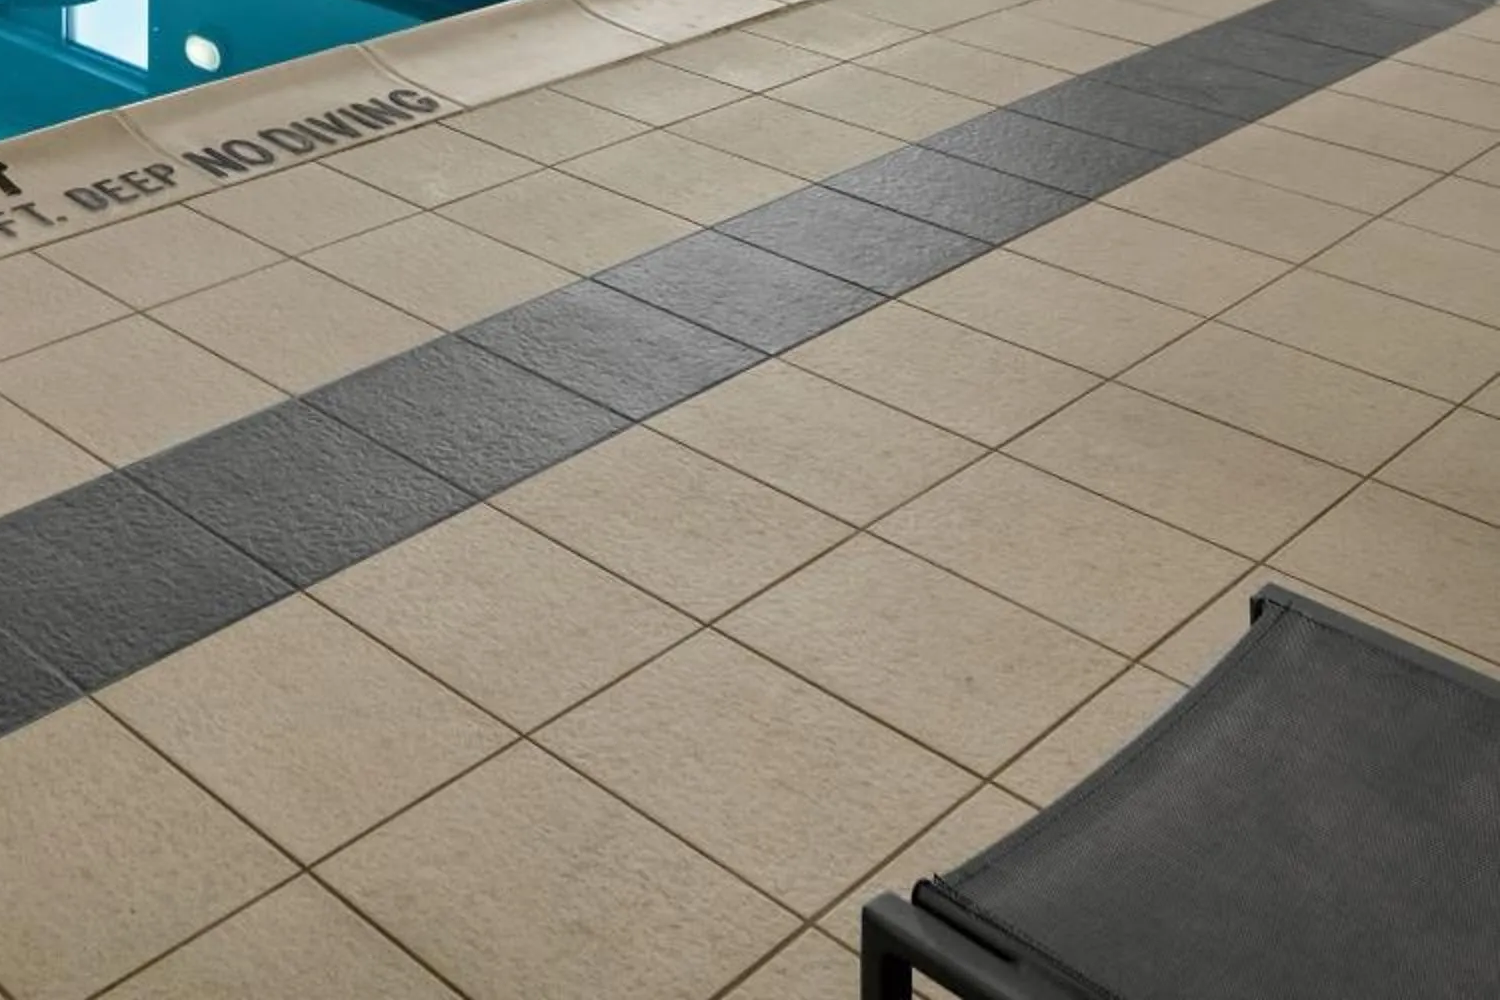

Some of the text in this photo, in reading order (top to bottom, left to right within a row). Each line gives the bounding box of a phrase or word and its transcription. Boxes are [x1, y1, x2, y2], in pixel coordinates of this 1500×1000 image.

[63, 164, 179, 212] DEEP
[182, 139, 276, 179] NO
[260, 88, 441, 156] DIVING
